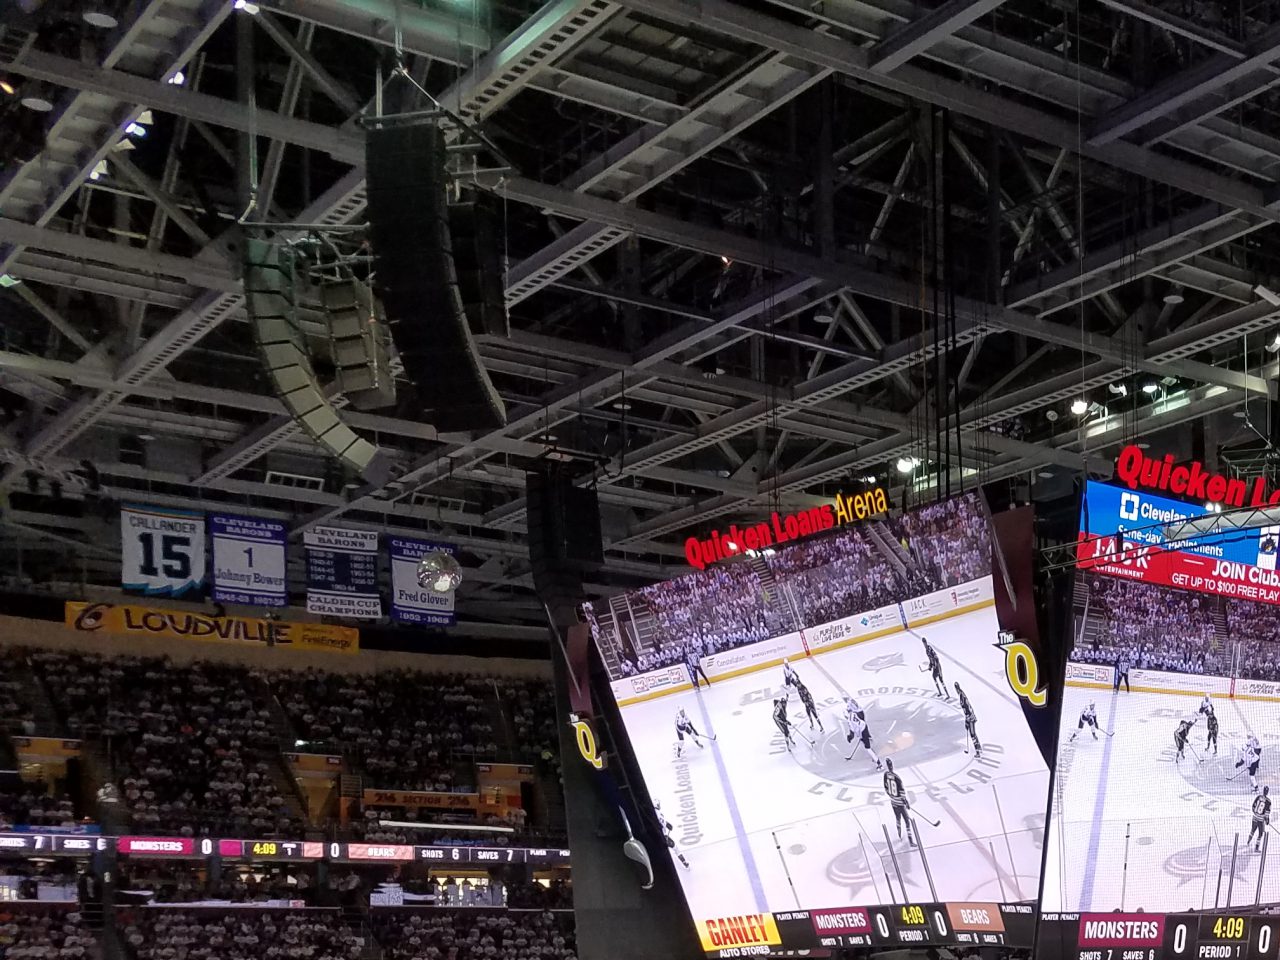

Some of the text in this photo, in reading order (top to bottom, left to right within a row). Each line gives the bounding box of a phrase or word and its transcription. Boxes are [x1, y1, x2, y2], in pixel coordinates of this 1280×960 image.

[1117, 444, 1247, 508] Quicken
[129, 515, 197, 534] CALLANDER
[213, 517, 284, 532] CLEVELAND
[225, 526, 273, 538] BARONS
[684, 487, 888, 571] Quicken Loans Arena
[317, 536, 366, 548] BARONS
[138, 532, 192, 580] 15
[243, 547, 254, 568] 1
[215, 568, 285, 586] Johnny Bower
[1211, 560, 1246, 581] JOIN
[1172, 573, 1189, 586] GET
[1191, 576, 1203, 587] UP
[1204, 579, 1216, 590] TO
[1217, 580, 1236, 594] $100
[1237, 584, 1258, 598] FREE
[1258, 589, 1280, 601] PLAY
[308, 595, 380, 608] CALDER CUP
[399, 590, 449, 606] Fred Glover
[309, 603, 379, 616] CHAMPIONS
[124, 608, 293, 644] LOUDVILLE
[997, 630, 1048, 706] The Q
[575, 720, 603, 769] Q
[33, 836, 44, 849] 7
[130, 840, 183, 852] MONSTERS
[201, 839, 212, 855] 0
[253, 843, 277, 855] 4:09
[330, 843, 339, 858] 0
[367, 847, 395, 857] BEARS
[422, 850, 443, 858] SHOTS
[452, 849, 460, 860] 6
[477, 850, 499, 861] SAVES
[506, 850, 513, 862] 7
[1001, 905, 1016, 913] PLAYER
[1041, 913, 1060, 921] PLAYER
[705, 914, 768, 947] GANLEY
[816, 906, 989, 938] MONSTERS 0 4:09 0 BEARS
[900, 930, 923, 942] PERIOD
[924, 930, 929, 941] 1
[1084, 920, 1158, 940] MONSTERS
[1173, 924, 1187, 953] 0
[1213, 917, 1244, 939] 4:09
[1258, 925, 1271, 954] 0
[720, 944, 771, 958] AUTO STORES
[1079, 950, 1101, 960] SHOTS
[1123, 951, 1144, 960] SAVES
[1199, 945, 1232, 959] PERIOD
[1235, 945, 1240, 958] 1
